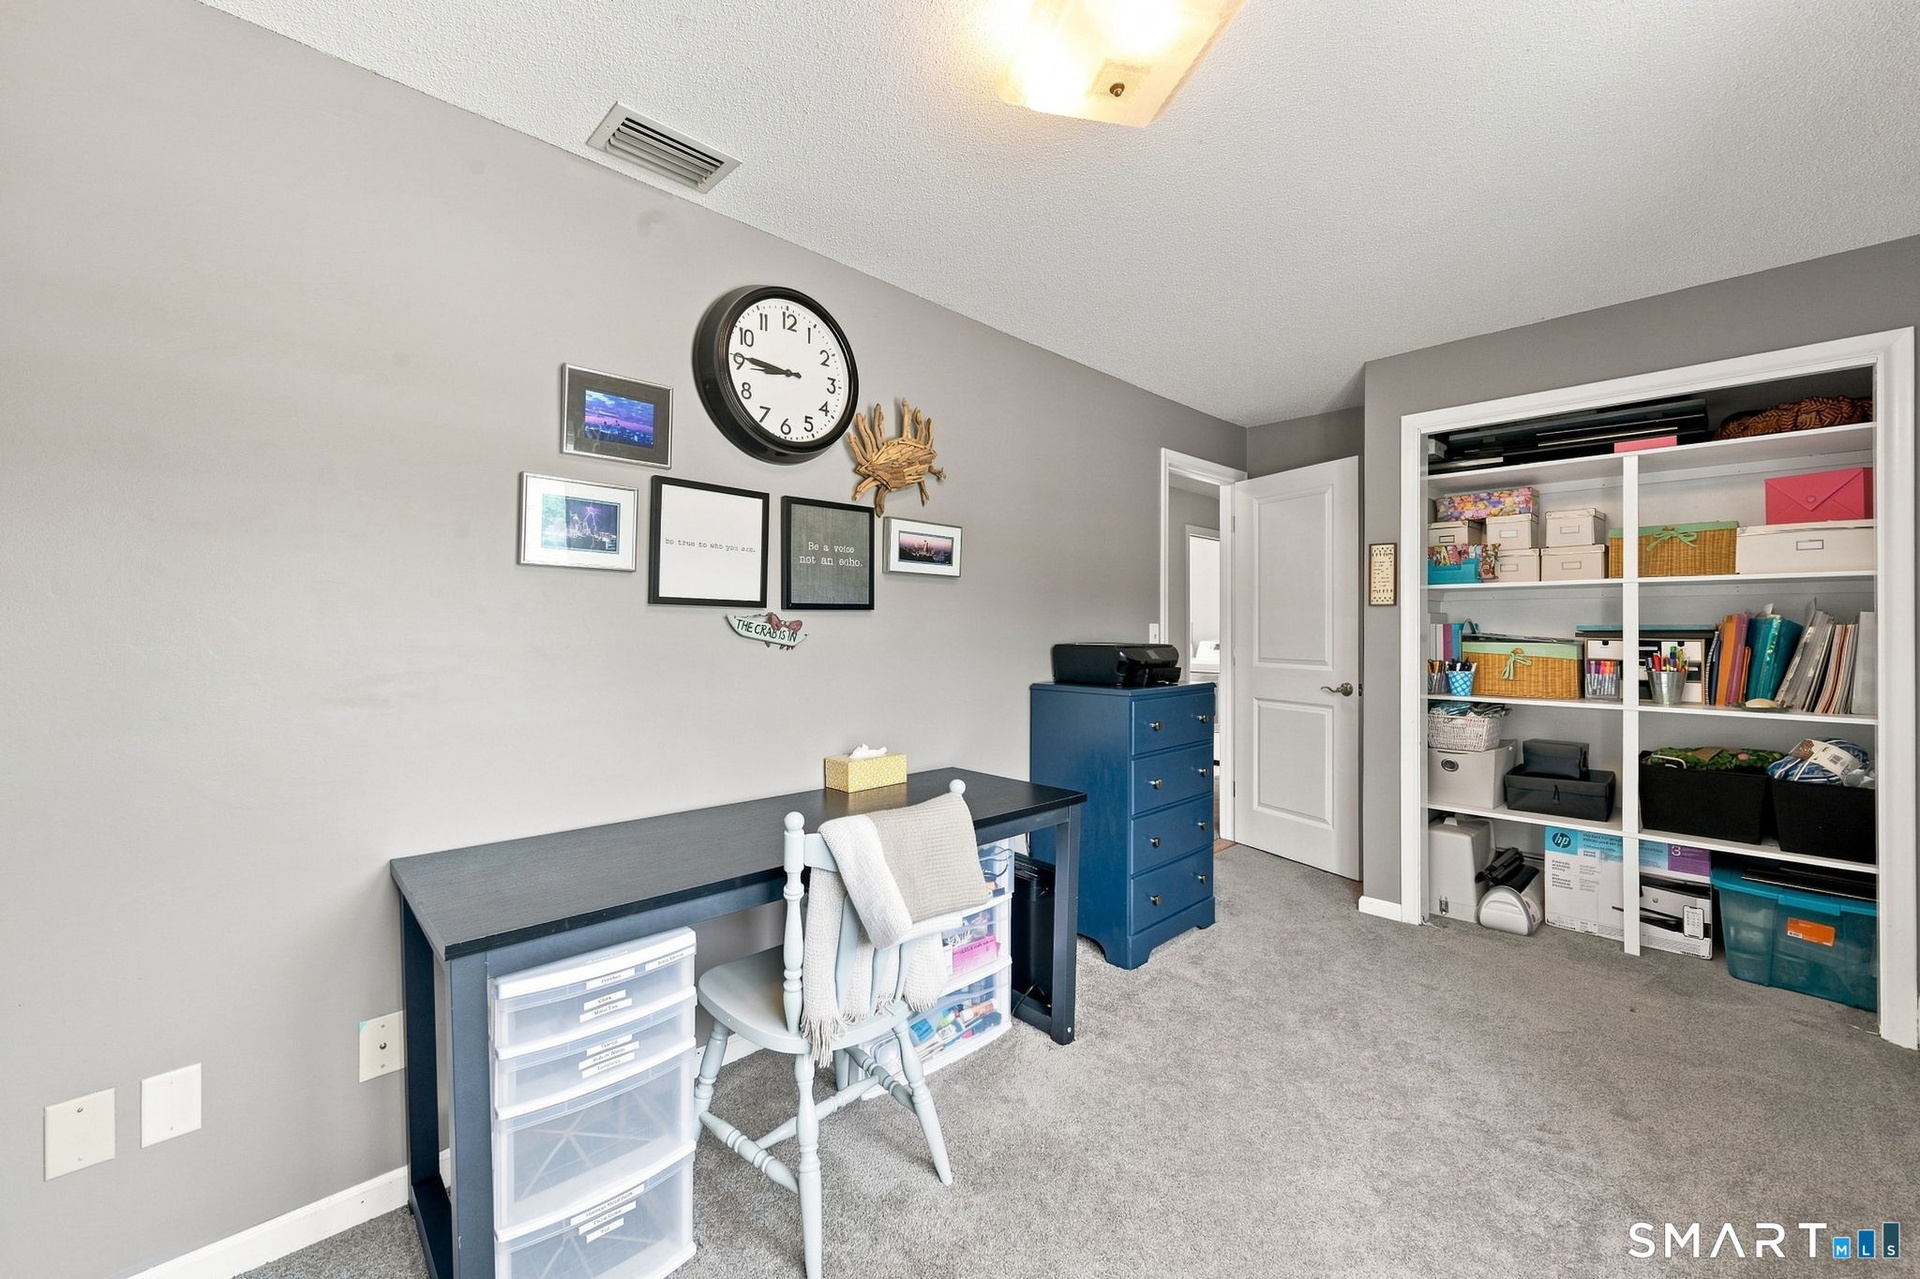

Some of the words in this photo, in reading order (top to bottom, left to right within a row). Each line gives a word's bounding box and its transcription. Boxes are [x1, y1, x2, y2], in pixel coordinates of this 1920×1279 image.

[759, 313, 768, 331] 11
[782, 311, 797, 332] 12
[739, 326, 754, 347] 10
[807, 327, 811, 344] 1
[733, 352, 745, 370] 9
[820, 350, 830, 367] 2
[741, 382, 752, 400] 8
[827, 377, 836, 394] 3
[759, 405, 771, 423] 7
[819, 401, 830, 416] 4
[780, 418, 792, 435] 6
[804, 415, 814, 432] 5
[823, 544, 830, 552] a
[799, 555, 816, 564] not
[820, 557, 834, 566] an
[736, 618, 754, 633] THE
[754, 624, 777, 639] CRAB
[779, 629, 786, 640] IS
[787, 630, 798, 643] IN
[1554, 832, 1570, 848] hp
